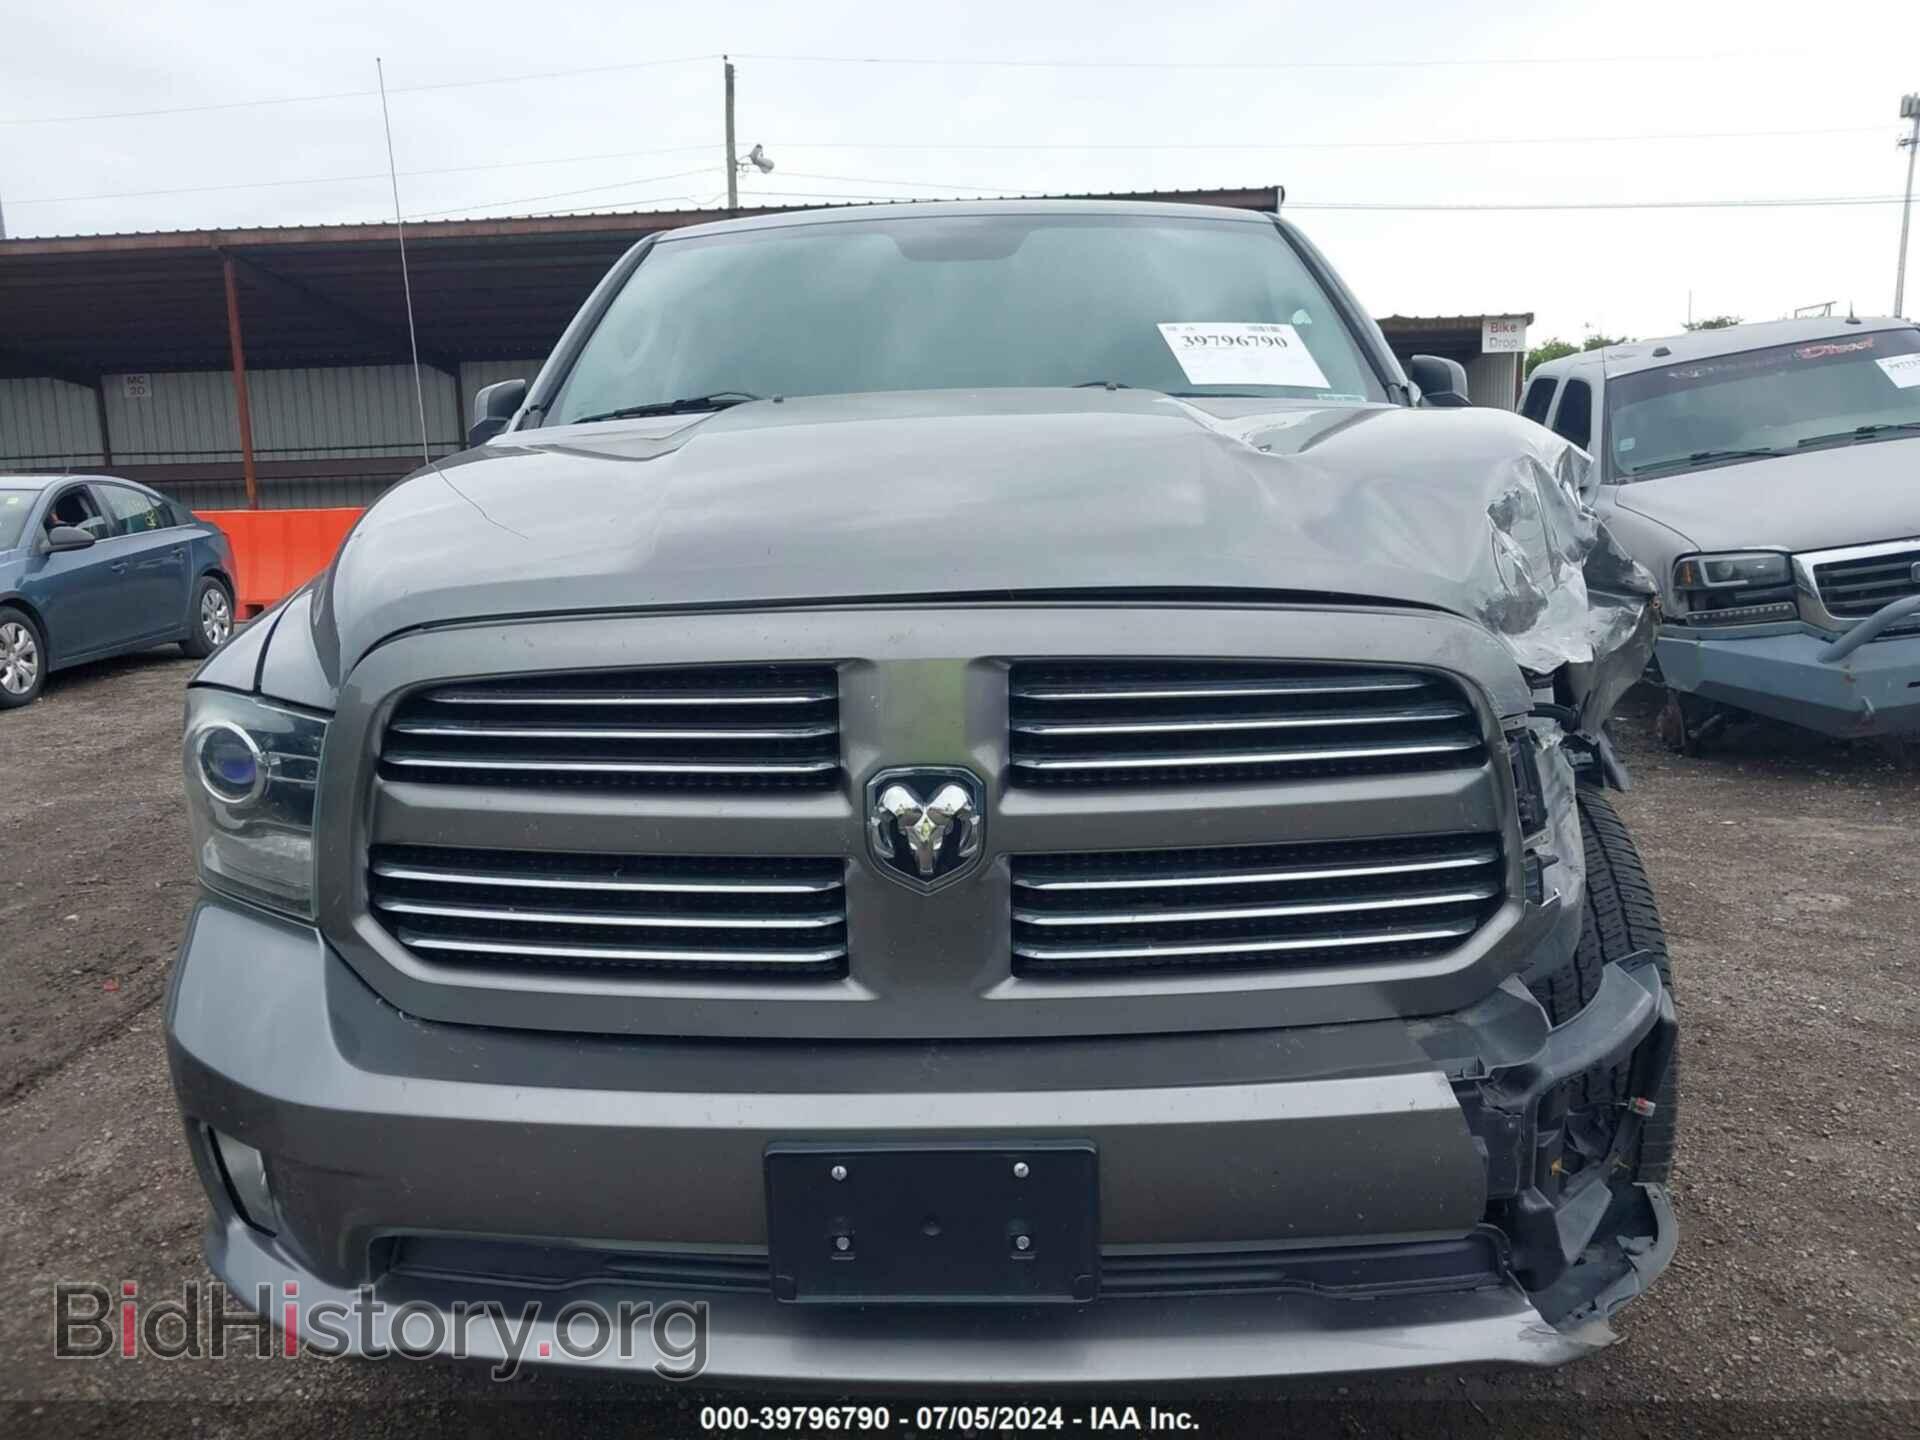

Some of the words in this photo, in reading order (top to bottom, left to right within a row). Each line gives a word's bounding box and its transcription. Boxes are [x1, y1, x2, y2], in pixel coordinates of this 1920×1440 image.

[1489, 322, 1518, 333] Bike
[1181, 335, 1288, 348] 39796790
[1490, 337, 1518, 350] Drop
